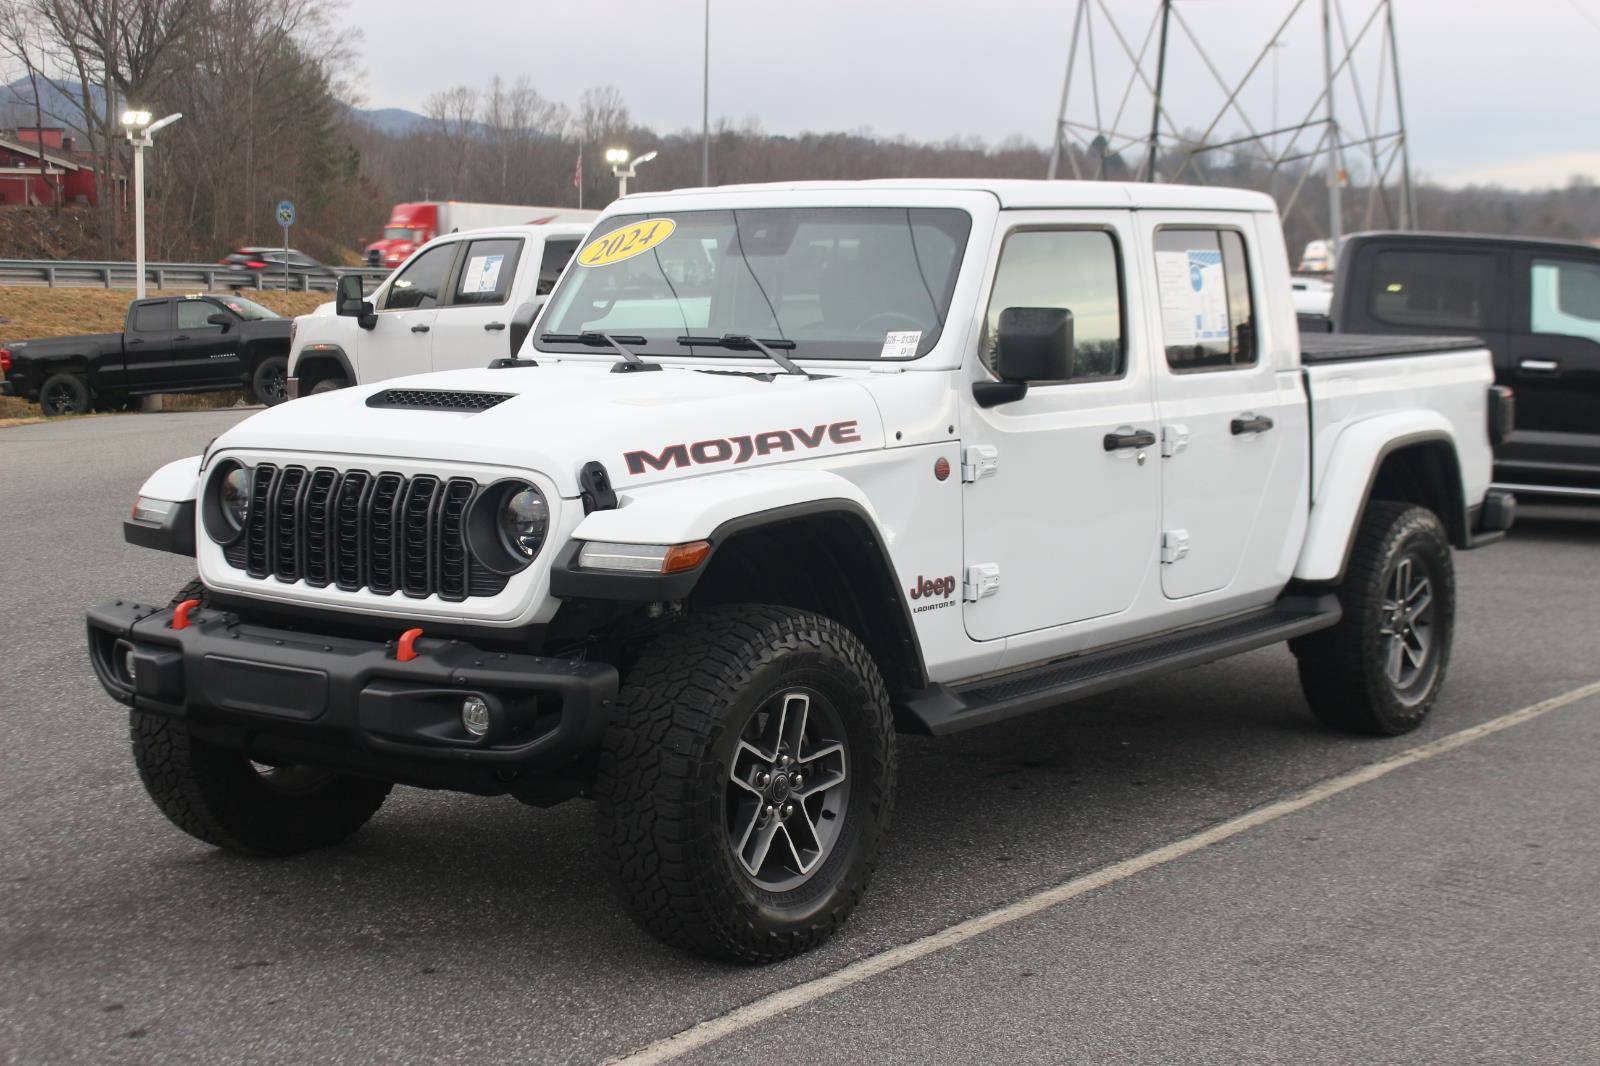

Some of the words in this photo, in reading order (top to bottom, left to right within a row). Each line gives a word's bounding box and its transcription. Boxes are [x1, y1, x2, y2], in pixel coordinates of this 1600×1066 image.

[587, 221, 661, 263] 2024
[623, 420, 862, 475] MOJAVE
[910, 575, 956, 600] Jeep
